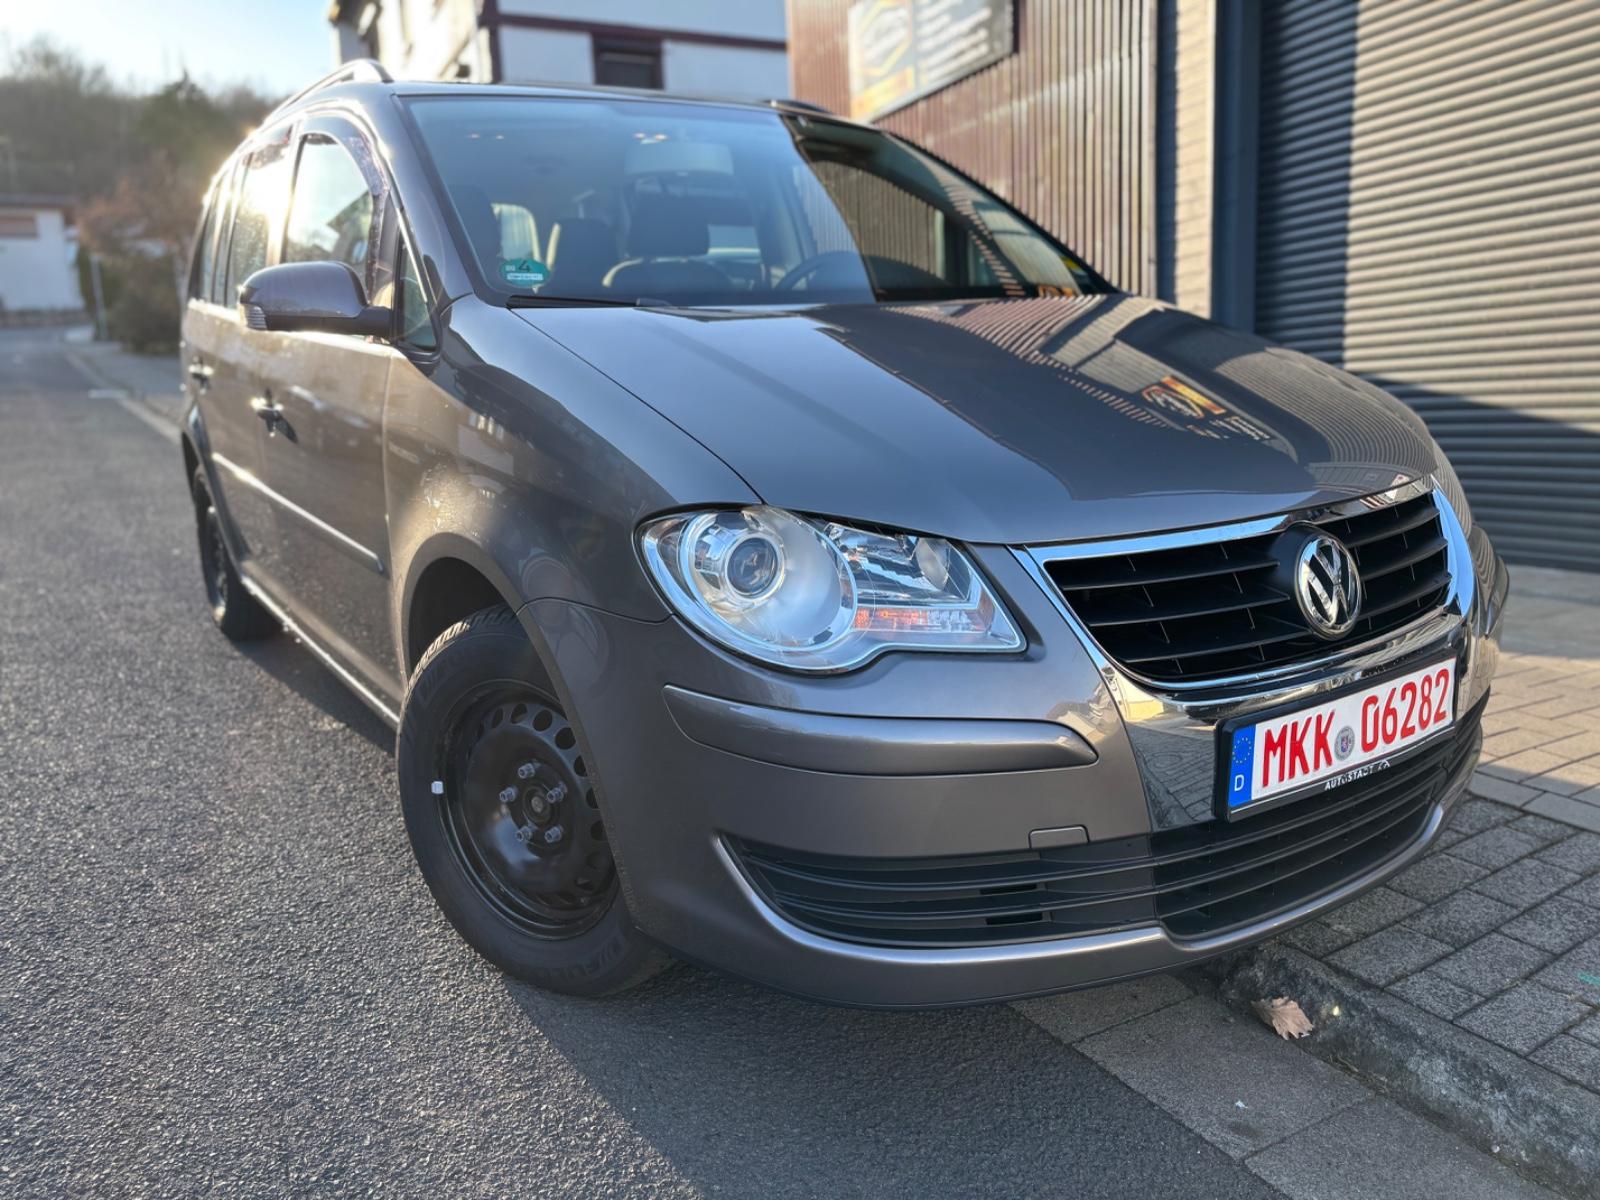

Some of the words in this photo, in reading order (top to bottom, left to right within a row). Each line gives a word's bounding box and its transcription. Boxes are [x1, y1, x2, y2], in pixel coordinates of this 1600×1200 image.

[1262, 710, 1335, 788] MKK
[1360, 668, 1450, 753] 06282
[1233, 774, 1245, 792] D
